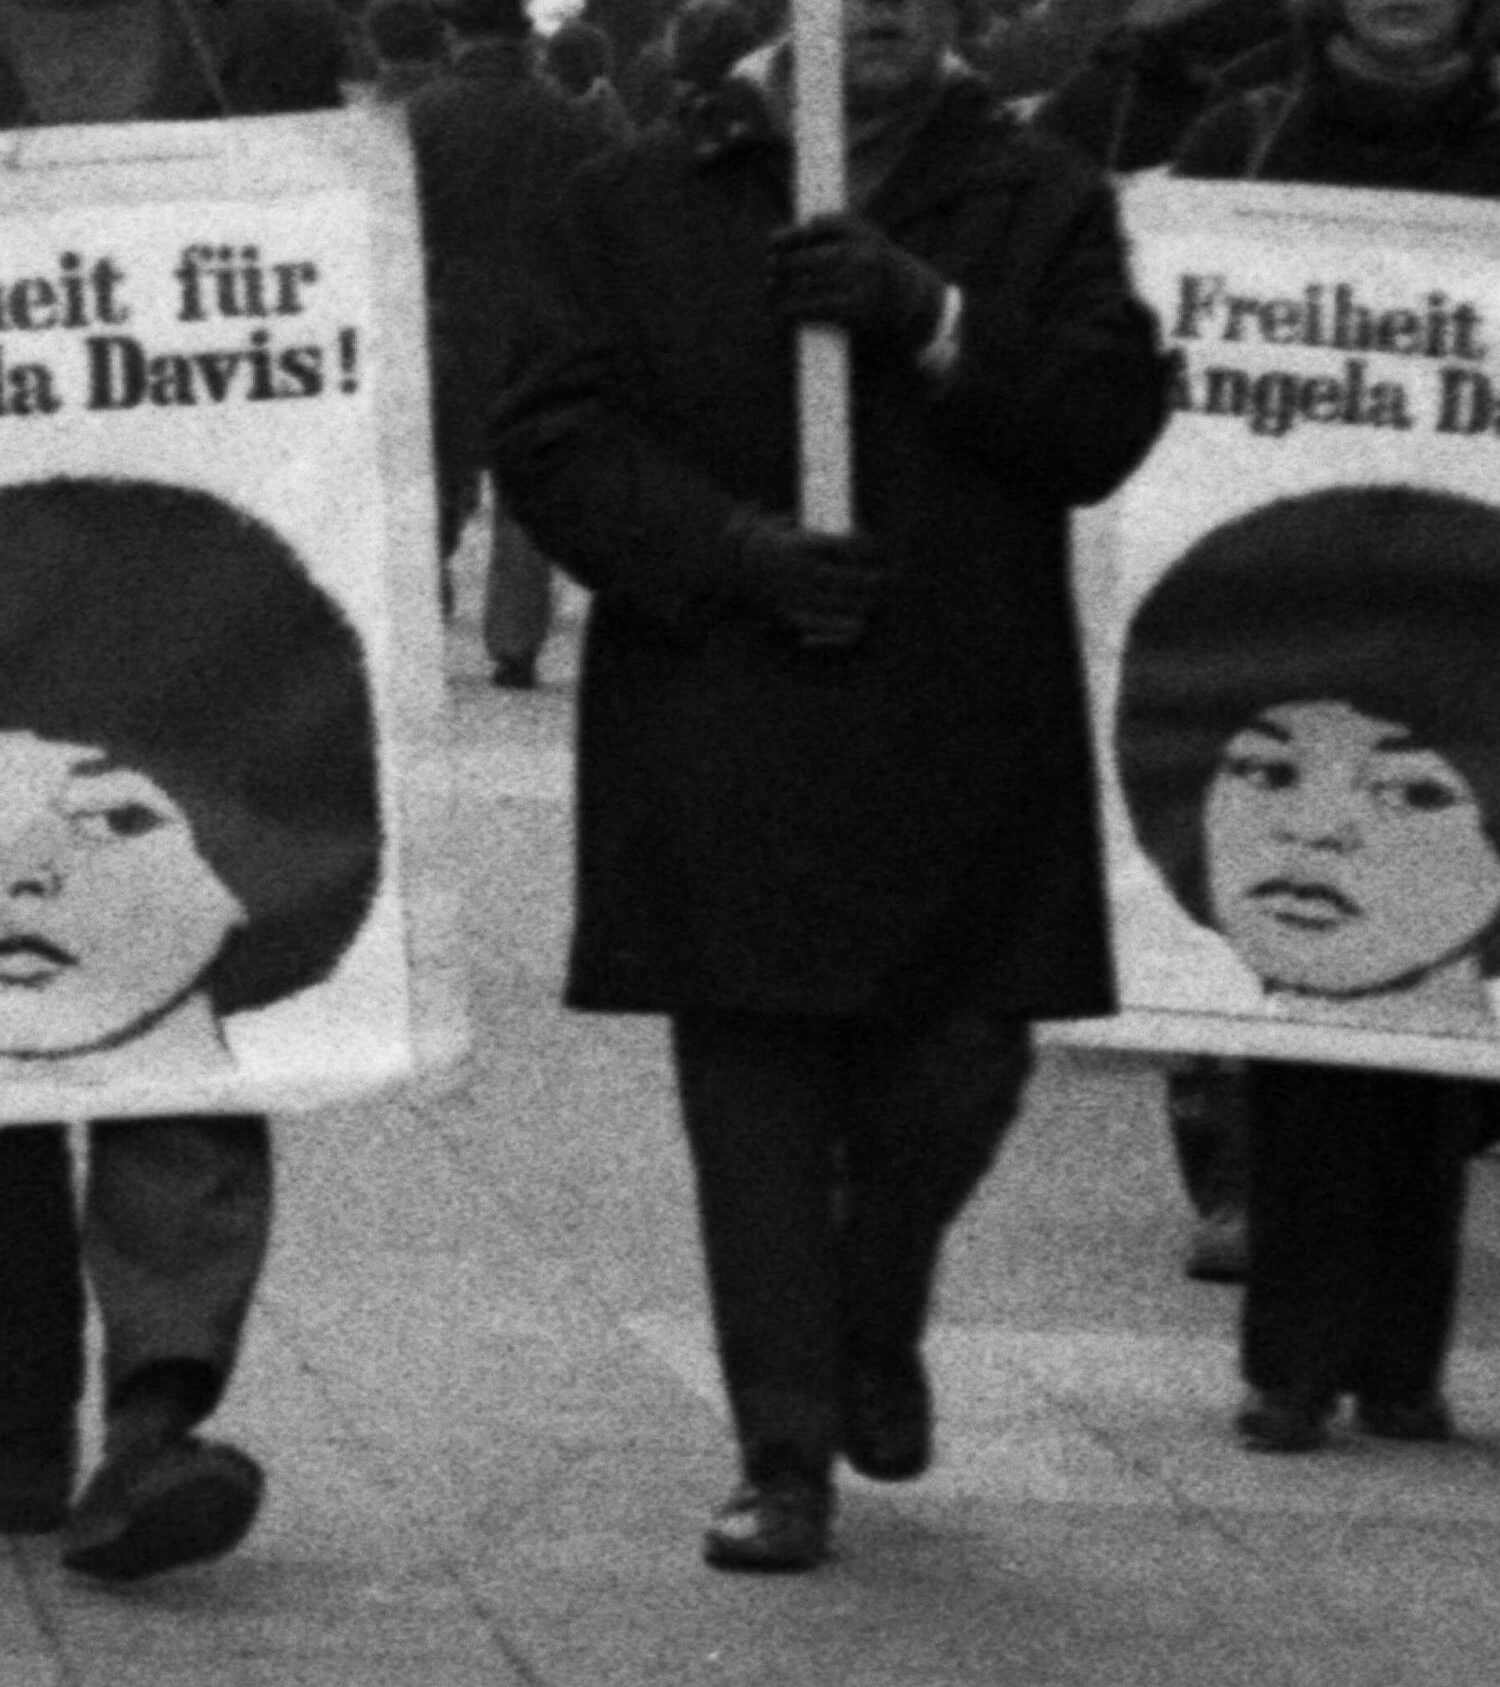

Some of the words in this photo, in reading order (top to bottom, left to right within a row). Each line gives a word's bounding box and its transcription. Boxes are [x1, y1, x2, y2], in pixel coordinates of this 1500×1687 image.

[175, 246, 317, 322] für
[1172, 276, 1486, 363] Freiheit
[87, 329, 356, 410] Davis!
